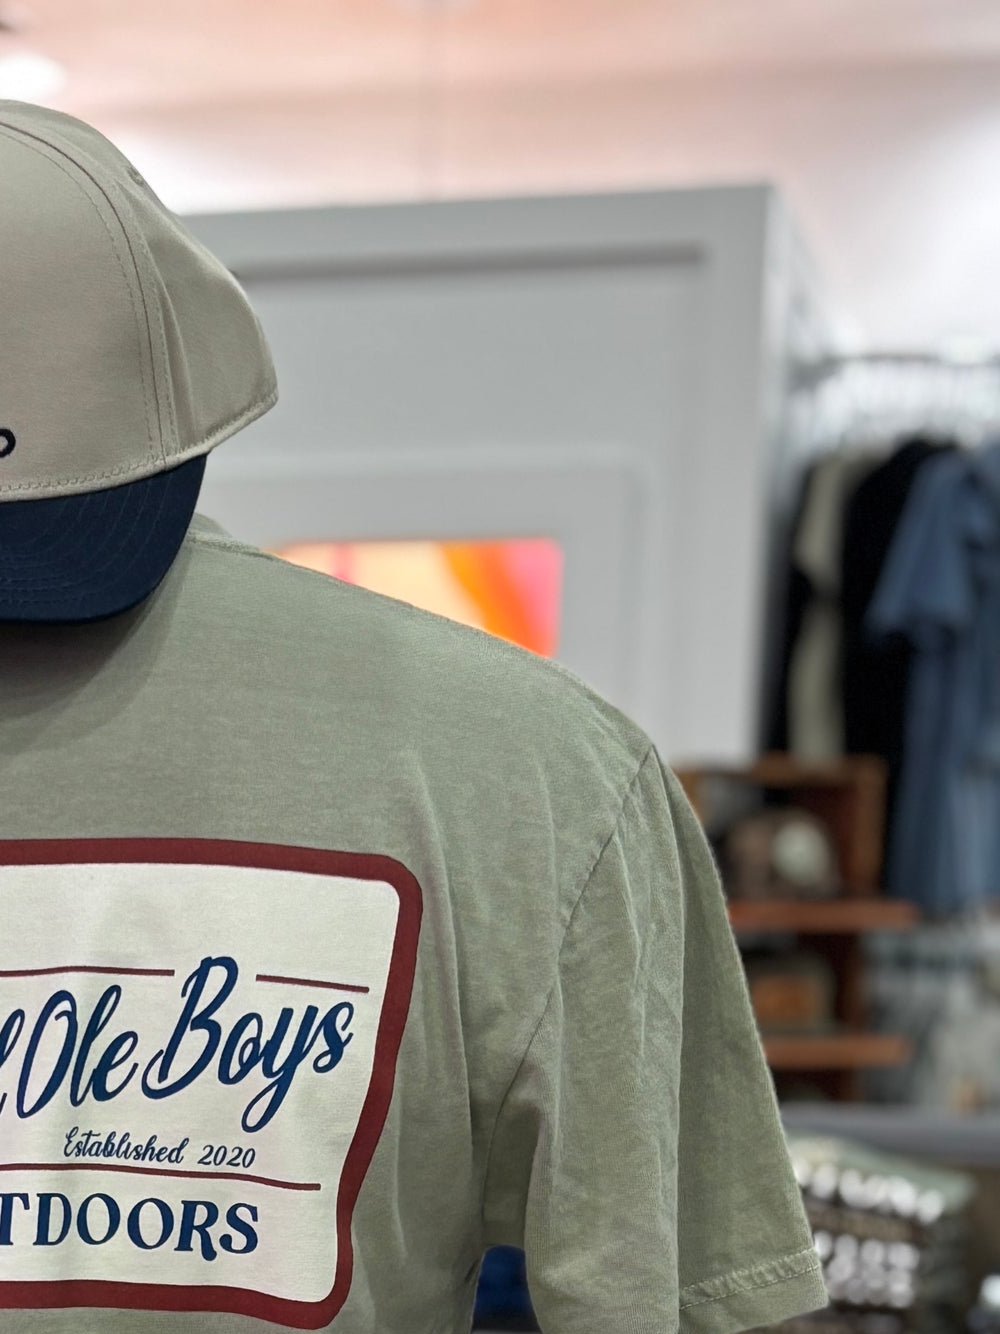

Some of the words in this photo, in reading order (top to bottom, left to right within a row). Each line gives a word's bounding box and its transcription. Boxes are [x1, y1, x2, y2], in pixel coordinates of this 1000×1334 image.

[16, 984, 139, 1119] Ole
[142, 955, 355, 1134] Boys
[63, 1126, 190, 1164] Established
[197, 1144, 256, 1168] 2020
